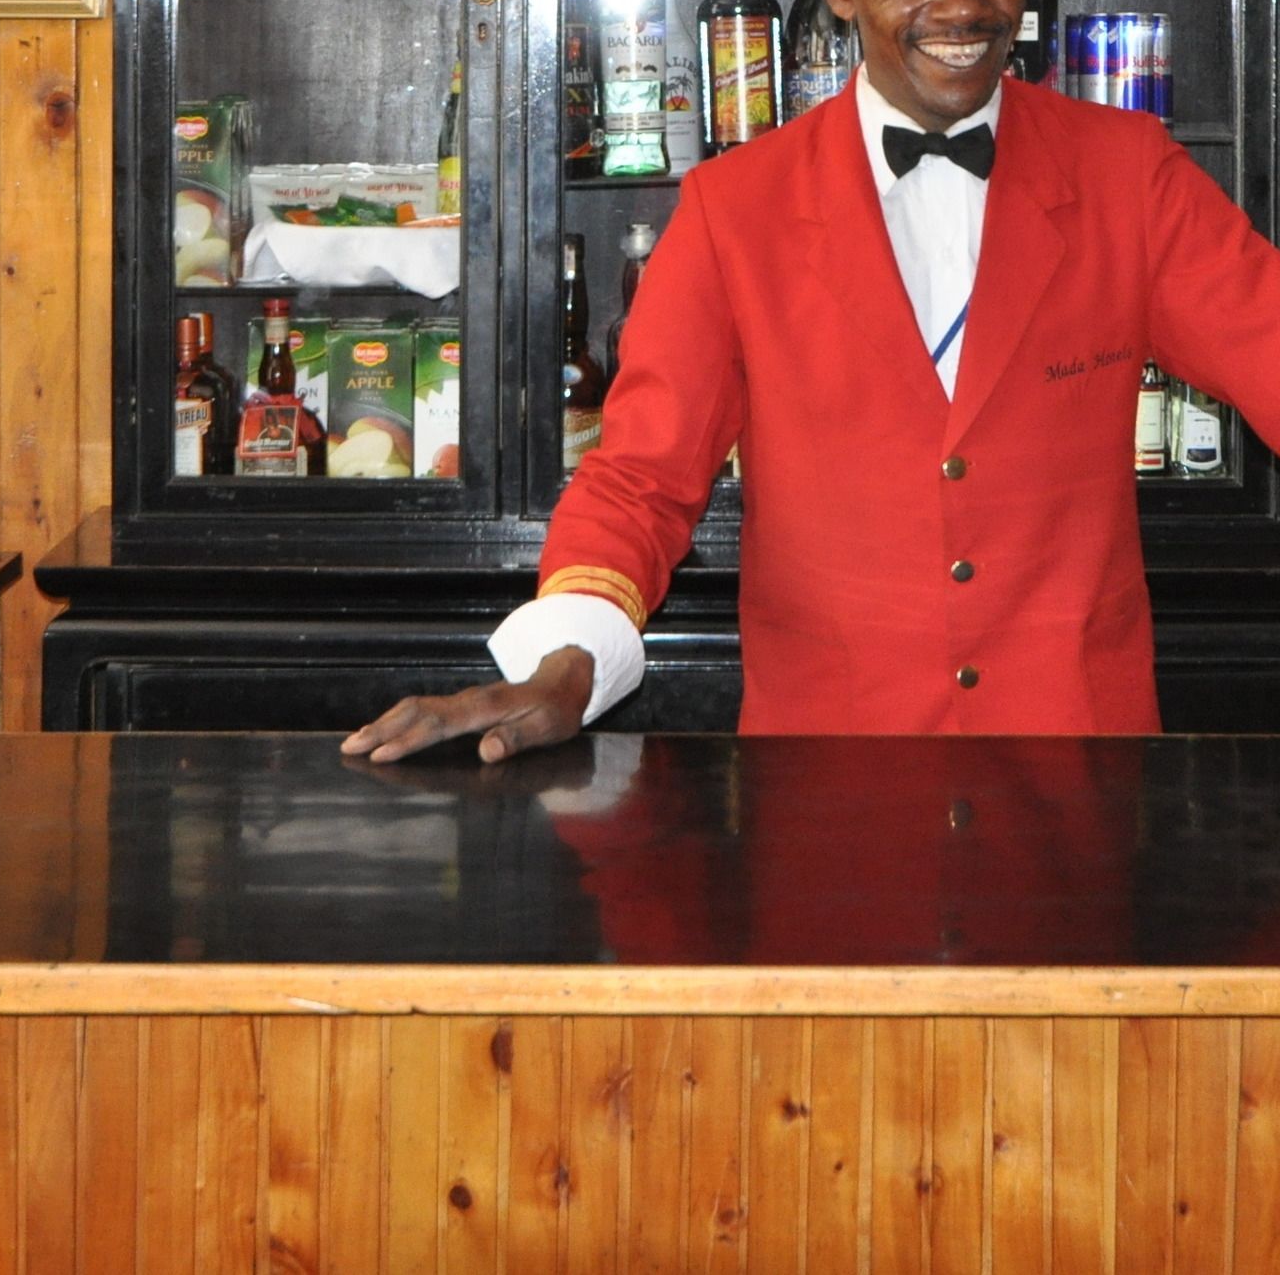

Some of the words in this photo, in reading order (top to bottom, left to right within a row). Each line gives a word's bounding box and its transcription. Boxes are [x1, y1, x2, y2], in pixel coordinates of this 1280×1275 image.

[178, 150, 214, 162] PPLE
[346, 376, 396, 390] APPLE
[176, 407, 208, 424] TREAU
